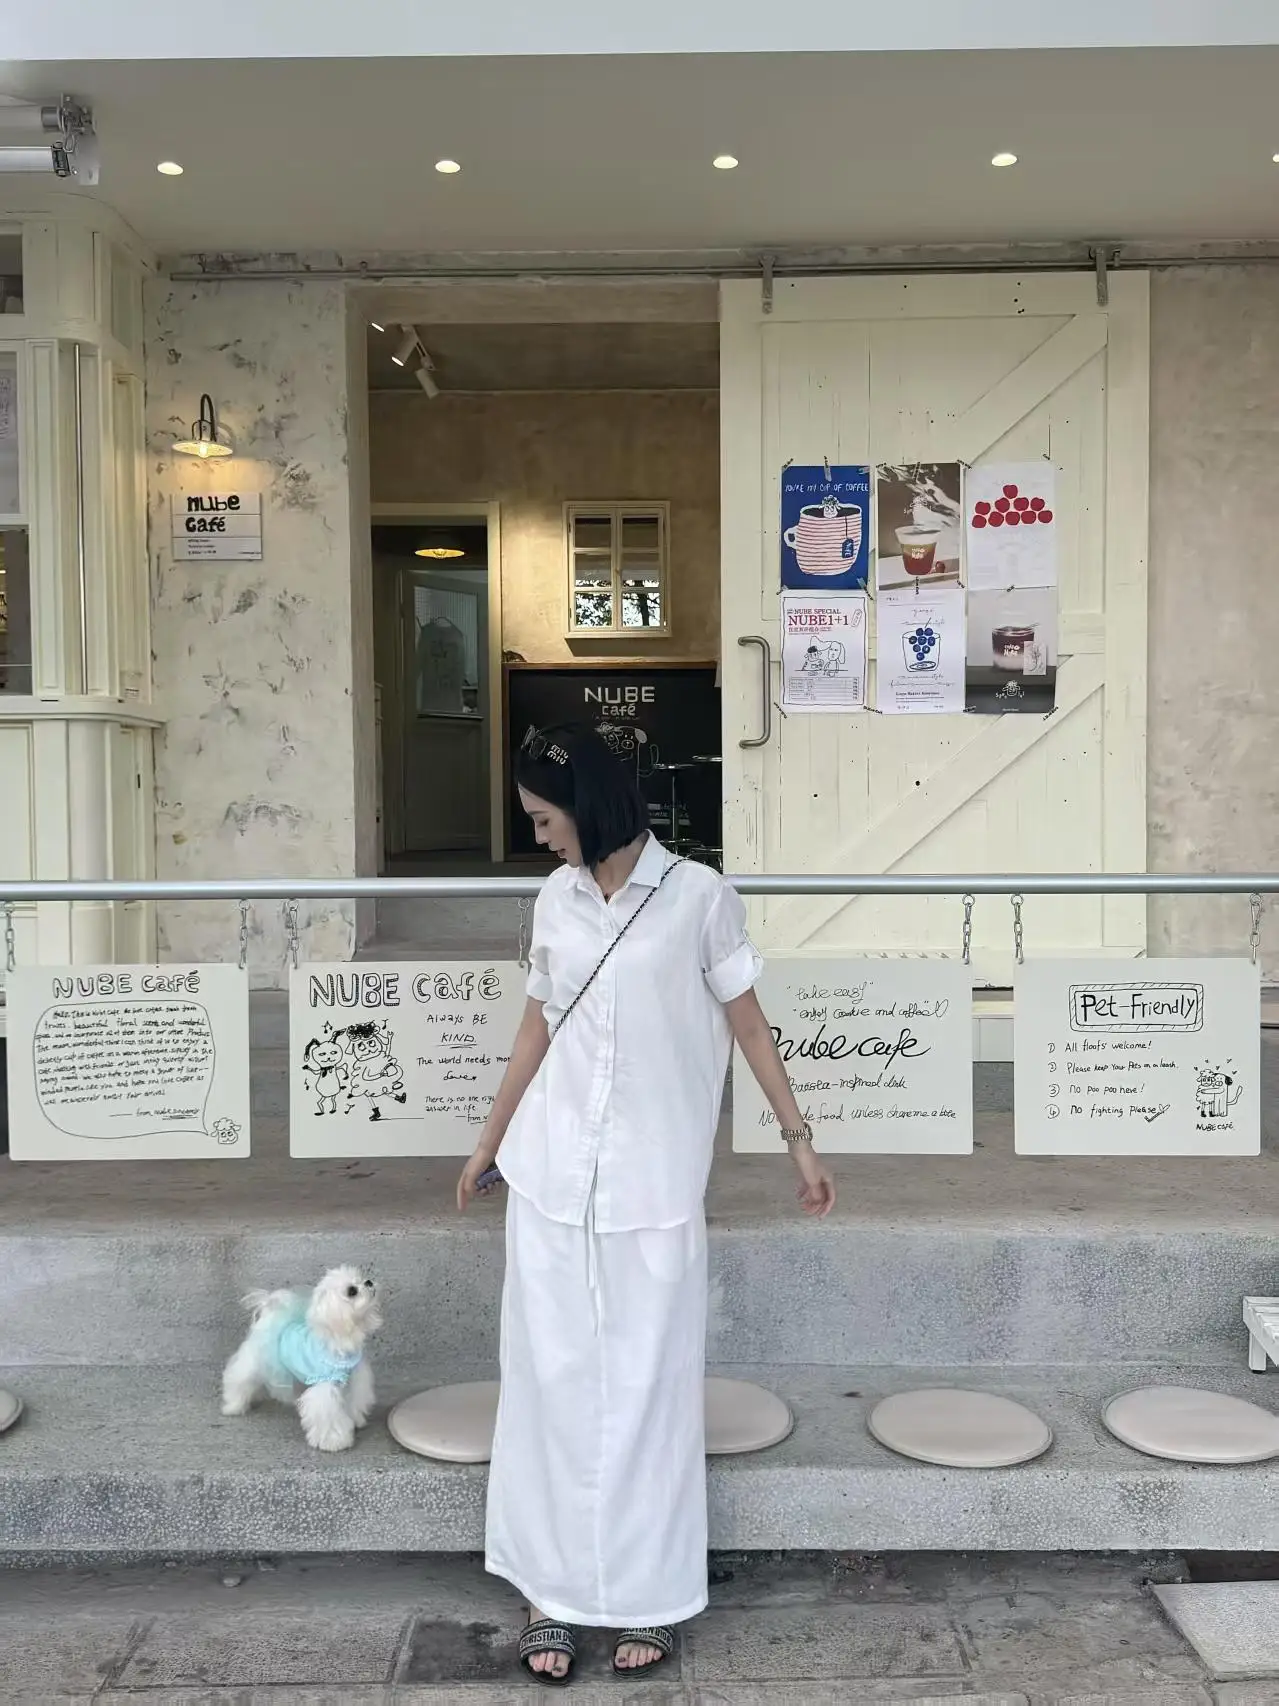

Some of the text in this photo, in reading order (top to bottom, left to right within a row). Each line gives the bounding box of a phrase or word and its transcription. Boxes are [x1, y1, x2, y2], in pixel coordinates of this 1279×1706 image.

[833, 483, 844, 492] OF
[845, 482, 869, 492] COFFEE
[584, 686, 656, 704] NUBE
[53, 973, 133, 999] NUBE
[309, 972, 401, 1008] NUBE
[875, 1001, 897, 1018] and
[1080, 993, 1196, 1022] Pet-Friendly
[472, 1013, 488, 1026] BE
[1065, 1042, 1077, 1052] All
[1111, 1040, 1152, 1051] welcome!
[416, 1056, 434, 1067] The
[438, 1054, 462, 1065] world
[465, 1053, 491, 1066] needs
[1067, 1061, 1092, 1075] Please
[425, 1095, 445, 1104] There
[447, 1096, 454, 1104] is
[1090, 1103, 1124, 1119] fighting
